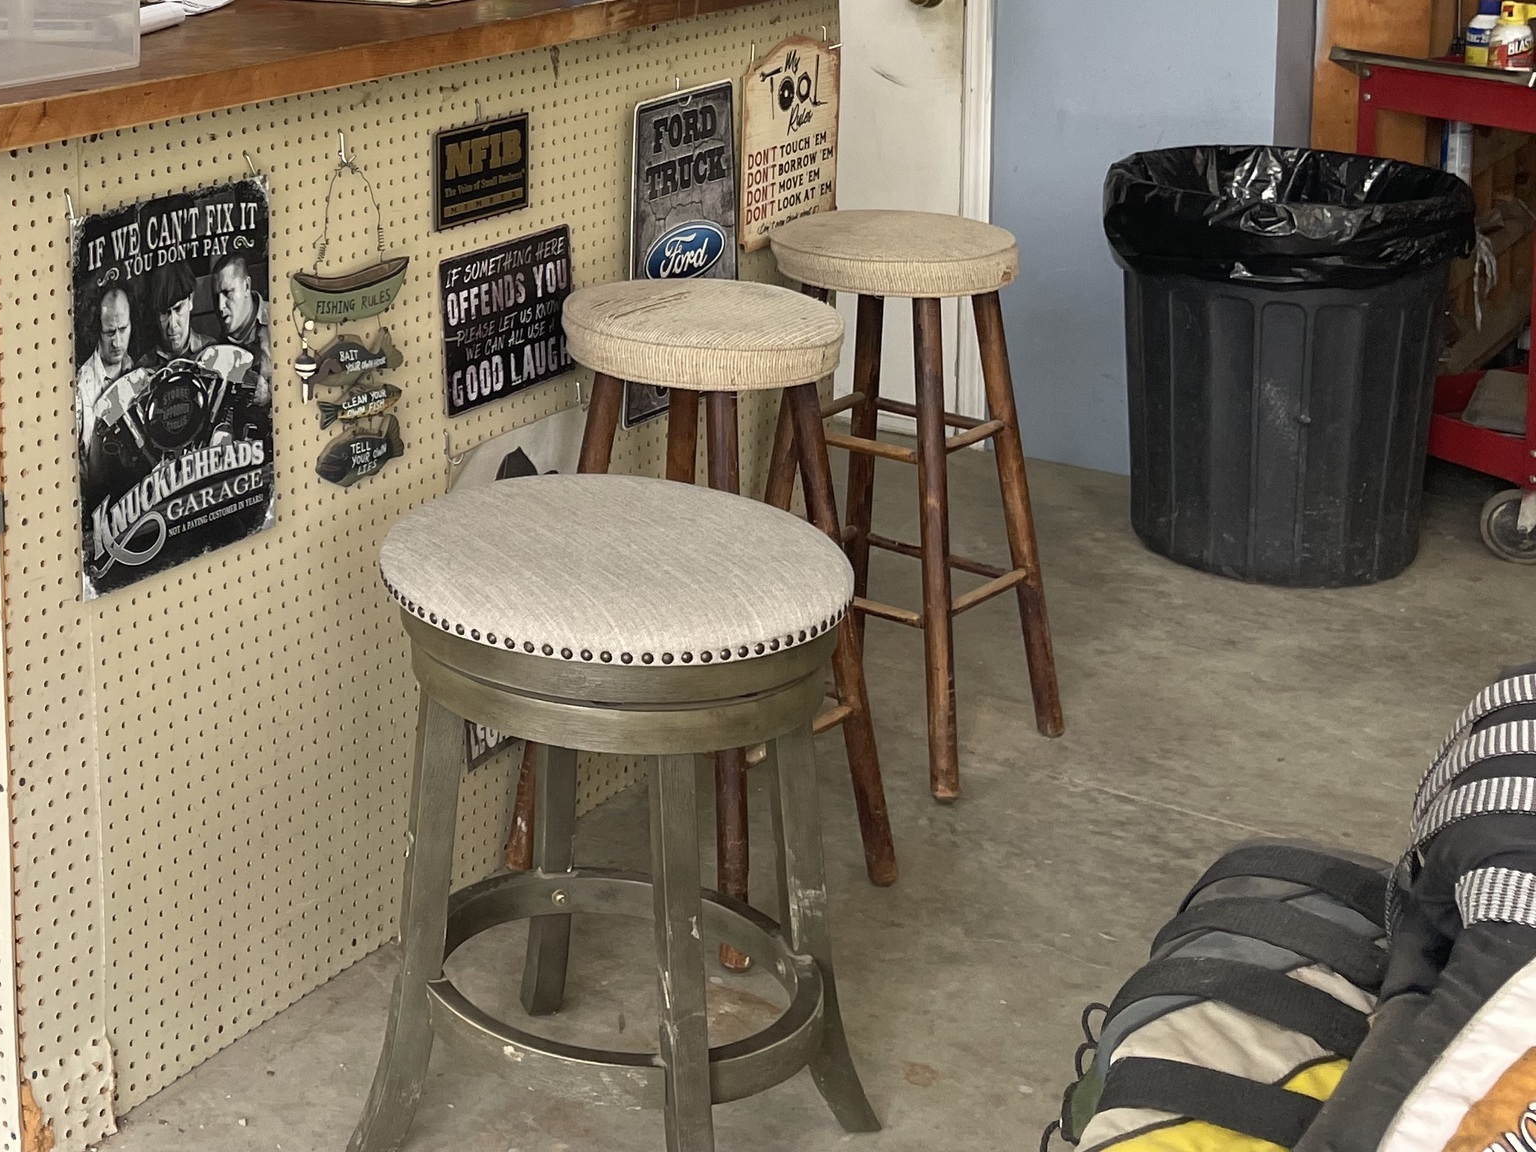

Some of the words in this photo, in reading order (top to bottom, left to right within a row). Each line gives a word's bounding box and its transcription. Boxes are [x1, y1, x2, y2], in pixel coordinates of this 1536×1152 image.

[653, 104, 715, 154] FORD
[445, 129, 522, 180] NFIB
[747, 164, 776, 188] DON'T
[778, 152, 817, 176] BORROW
[748, 146, 777, 170] DON'T
[780, 136, 810, 158] TOUCH
[813, 131, 826, 146] 'EM
[645, 146, 727, 201] TRUCK
[747, 182, 776, 207] DON'T
[779, 174, 803, 194] MOVE
[746, 200, 775, 225] DON'T
[778, 192, 801, 211] LOOK
[804, 187, 816, 202] AT
[88, 236, 106, 271] IF
[111, 222, 141, 261] WE
[147, 207, 199, 250] CAN'T
[205, 203, 235, 236] FIX
[240, 203, 258, 230] IT
[659, 232, 709, 278] Ford
[125, 252, 154, 280] YOU
[158, 241, 199, 266] DON'T
[203, 236, 230, 256] PAY
[446, 267, 462, 288] IF
[464, 246, 532, 283] SOMETHING
[535, 237, 565, 260] HERE
[316, 298, 355, 315] FISHING
[362, 288, 391, 307] RULES
[446, 272, 526, 326] OFFENDS
[532, 258, 567, 298] YOU
[457, 320, 495, 347] PLEASE
[498, 312, 517, 333] LET
[520, 307, 532, 323] US
[465, 344, 481, 361] WE
[484, 337, 503, 356] CAN
[508, 329, 525, 347] ALL
[528, 321, 546, 338] USE
[339, 350, 358, 361] BAIT
[346, 361, 361, 374] YOUR
[343, 394, 368, 409] CLEAN
[370, 389, 386, 402] YOUR
[452, 354, 504, 407] GOOD
[347, 406, 365, 417] OWN
[350, 441, 371, 454] TELL
[352, 452, 370, 468] YOUR
[373, 443, 387, 458] OWN
[357, 459, 377, 475] LIES
[91, 440, 264, 560] KNUCKLEHEADS
[166, 469, 264, 521] GARAGE
[187, 515, 209, 530] PAYING
[209, 504, 237, 521] CUSTOMER
[238, 502, 244, 512] IN
